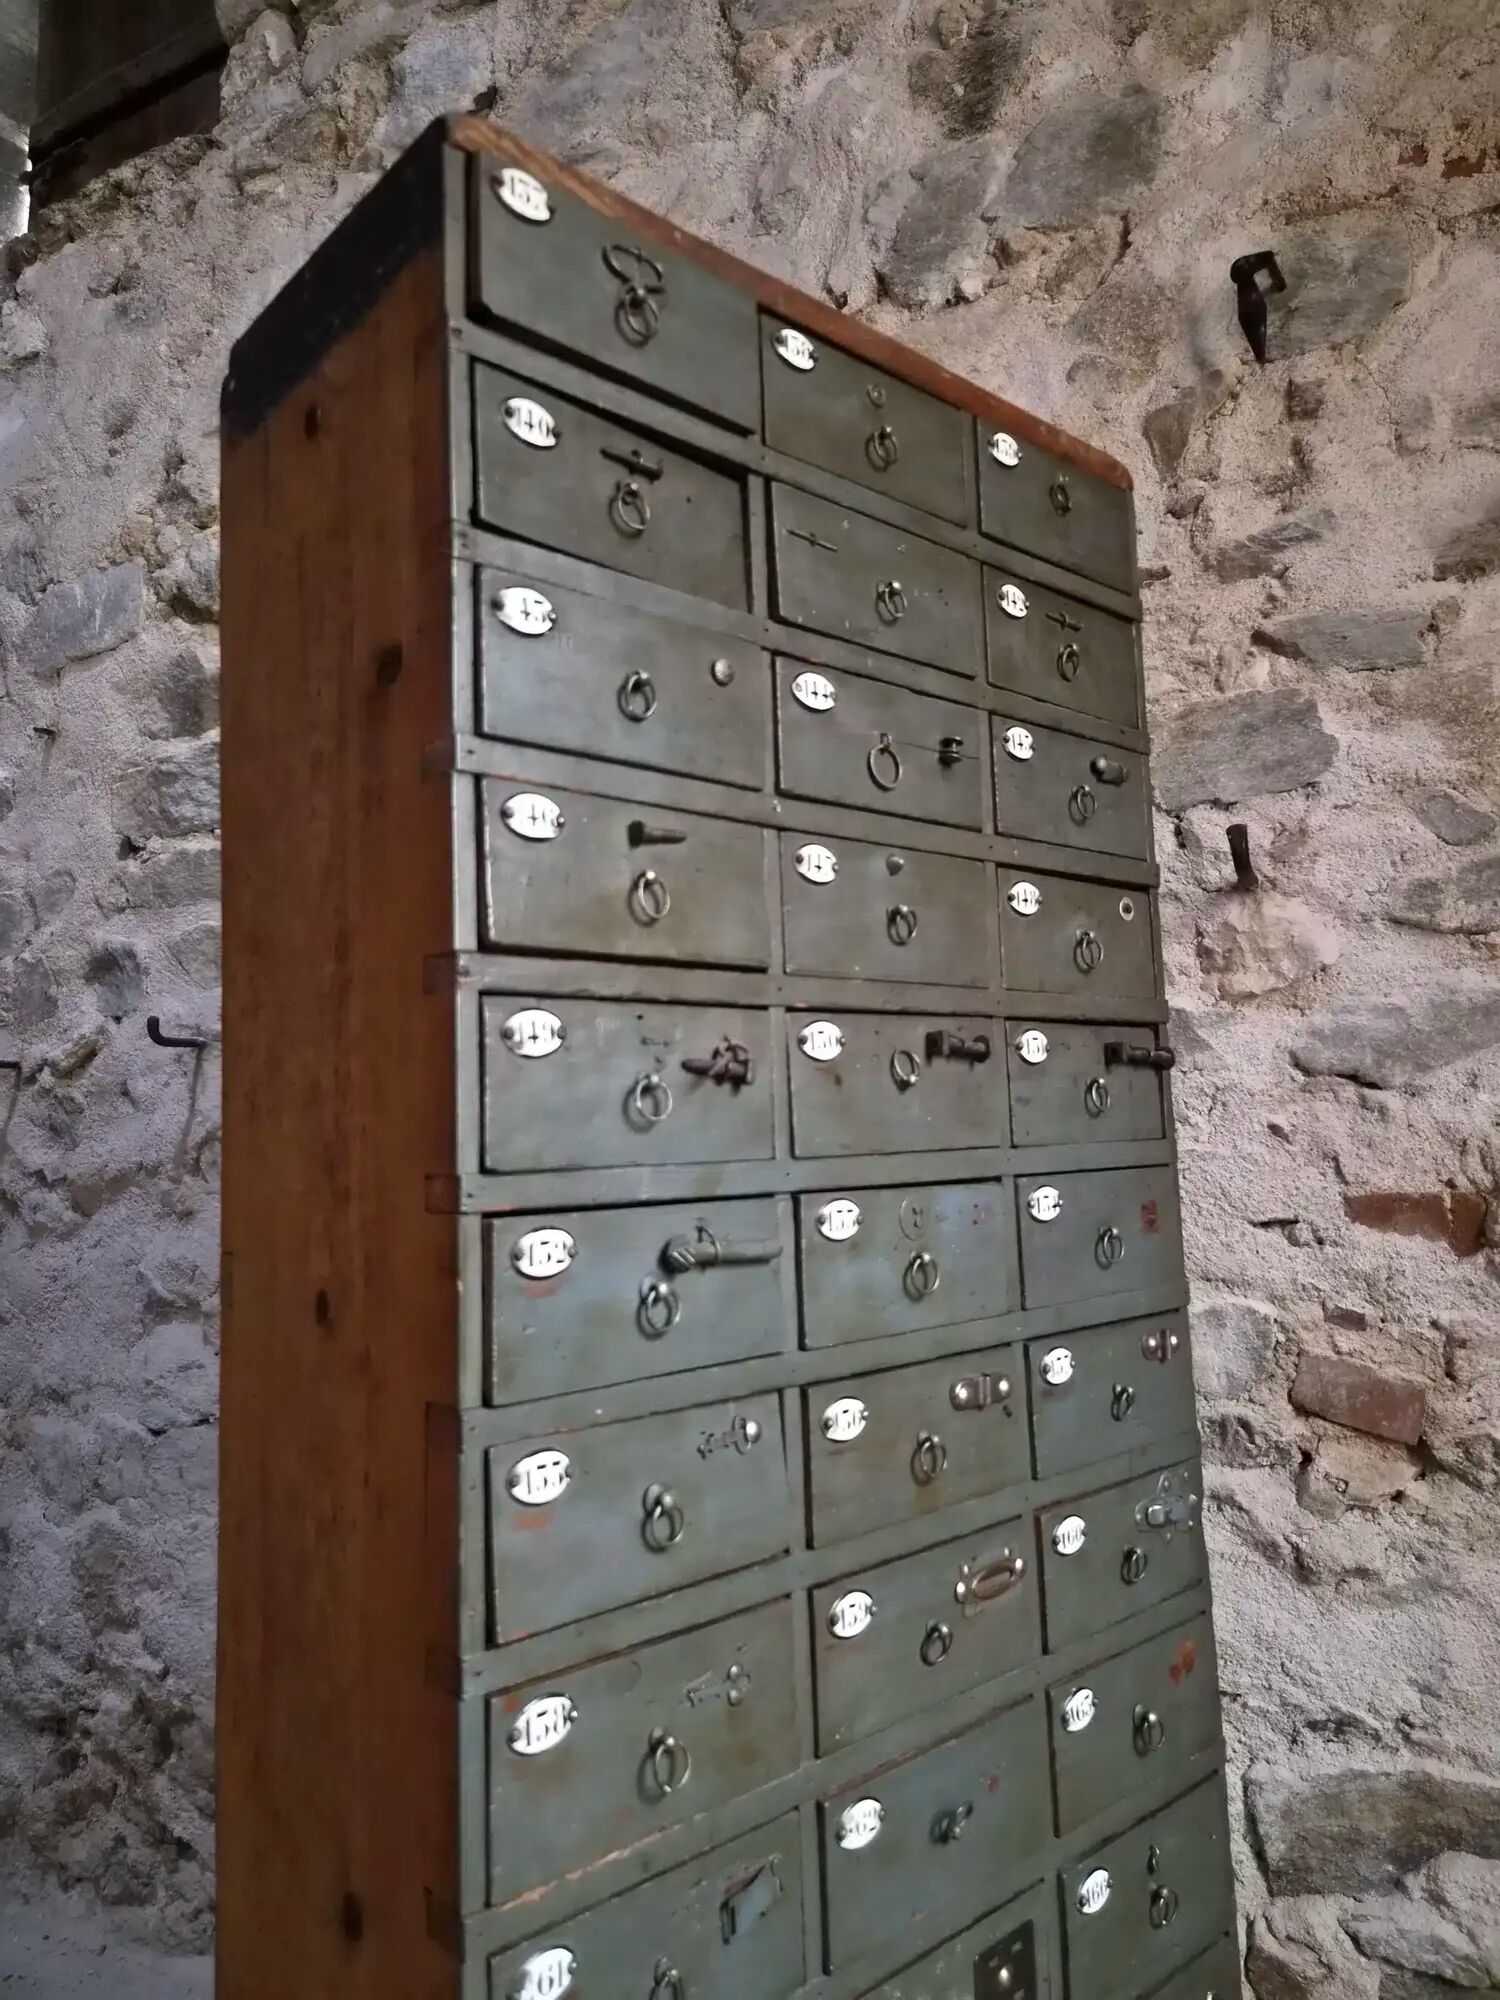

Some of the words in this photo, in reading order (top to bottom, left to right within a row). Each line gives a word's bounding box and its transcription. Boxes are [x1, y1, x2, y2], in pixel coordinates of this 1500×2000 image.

[516, 407, 551, 440] 140
[511, 595, 547, 625] 43
[804, 679, 832, 704] 144
[518, 803, 557, 827] 46
[529, 1239, 568, 1268] 152
[840, 1602, 869, 1631] 159
[528, 1960, 564, 1998] 61
